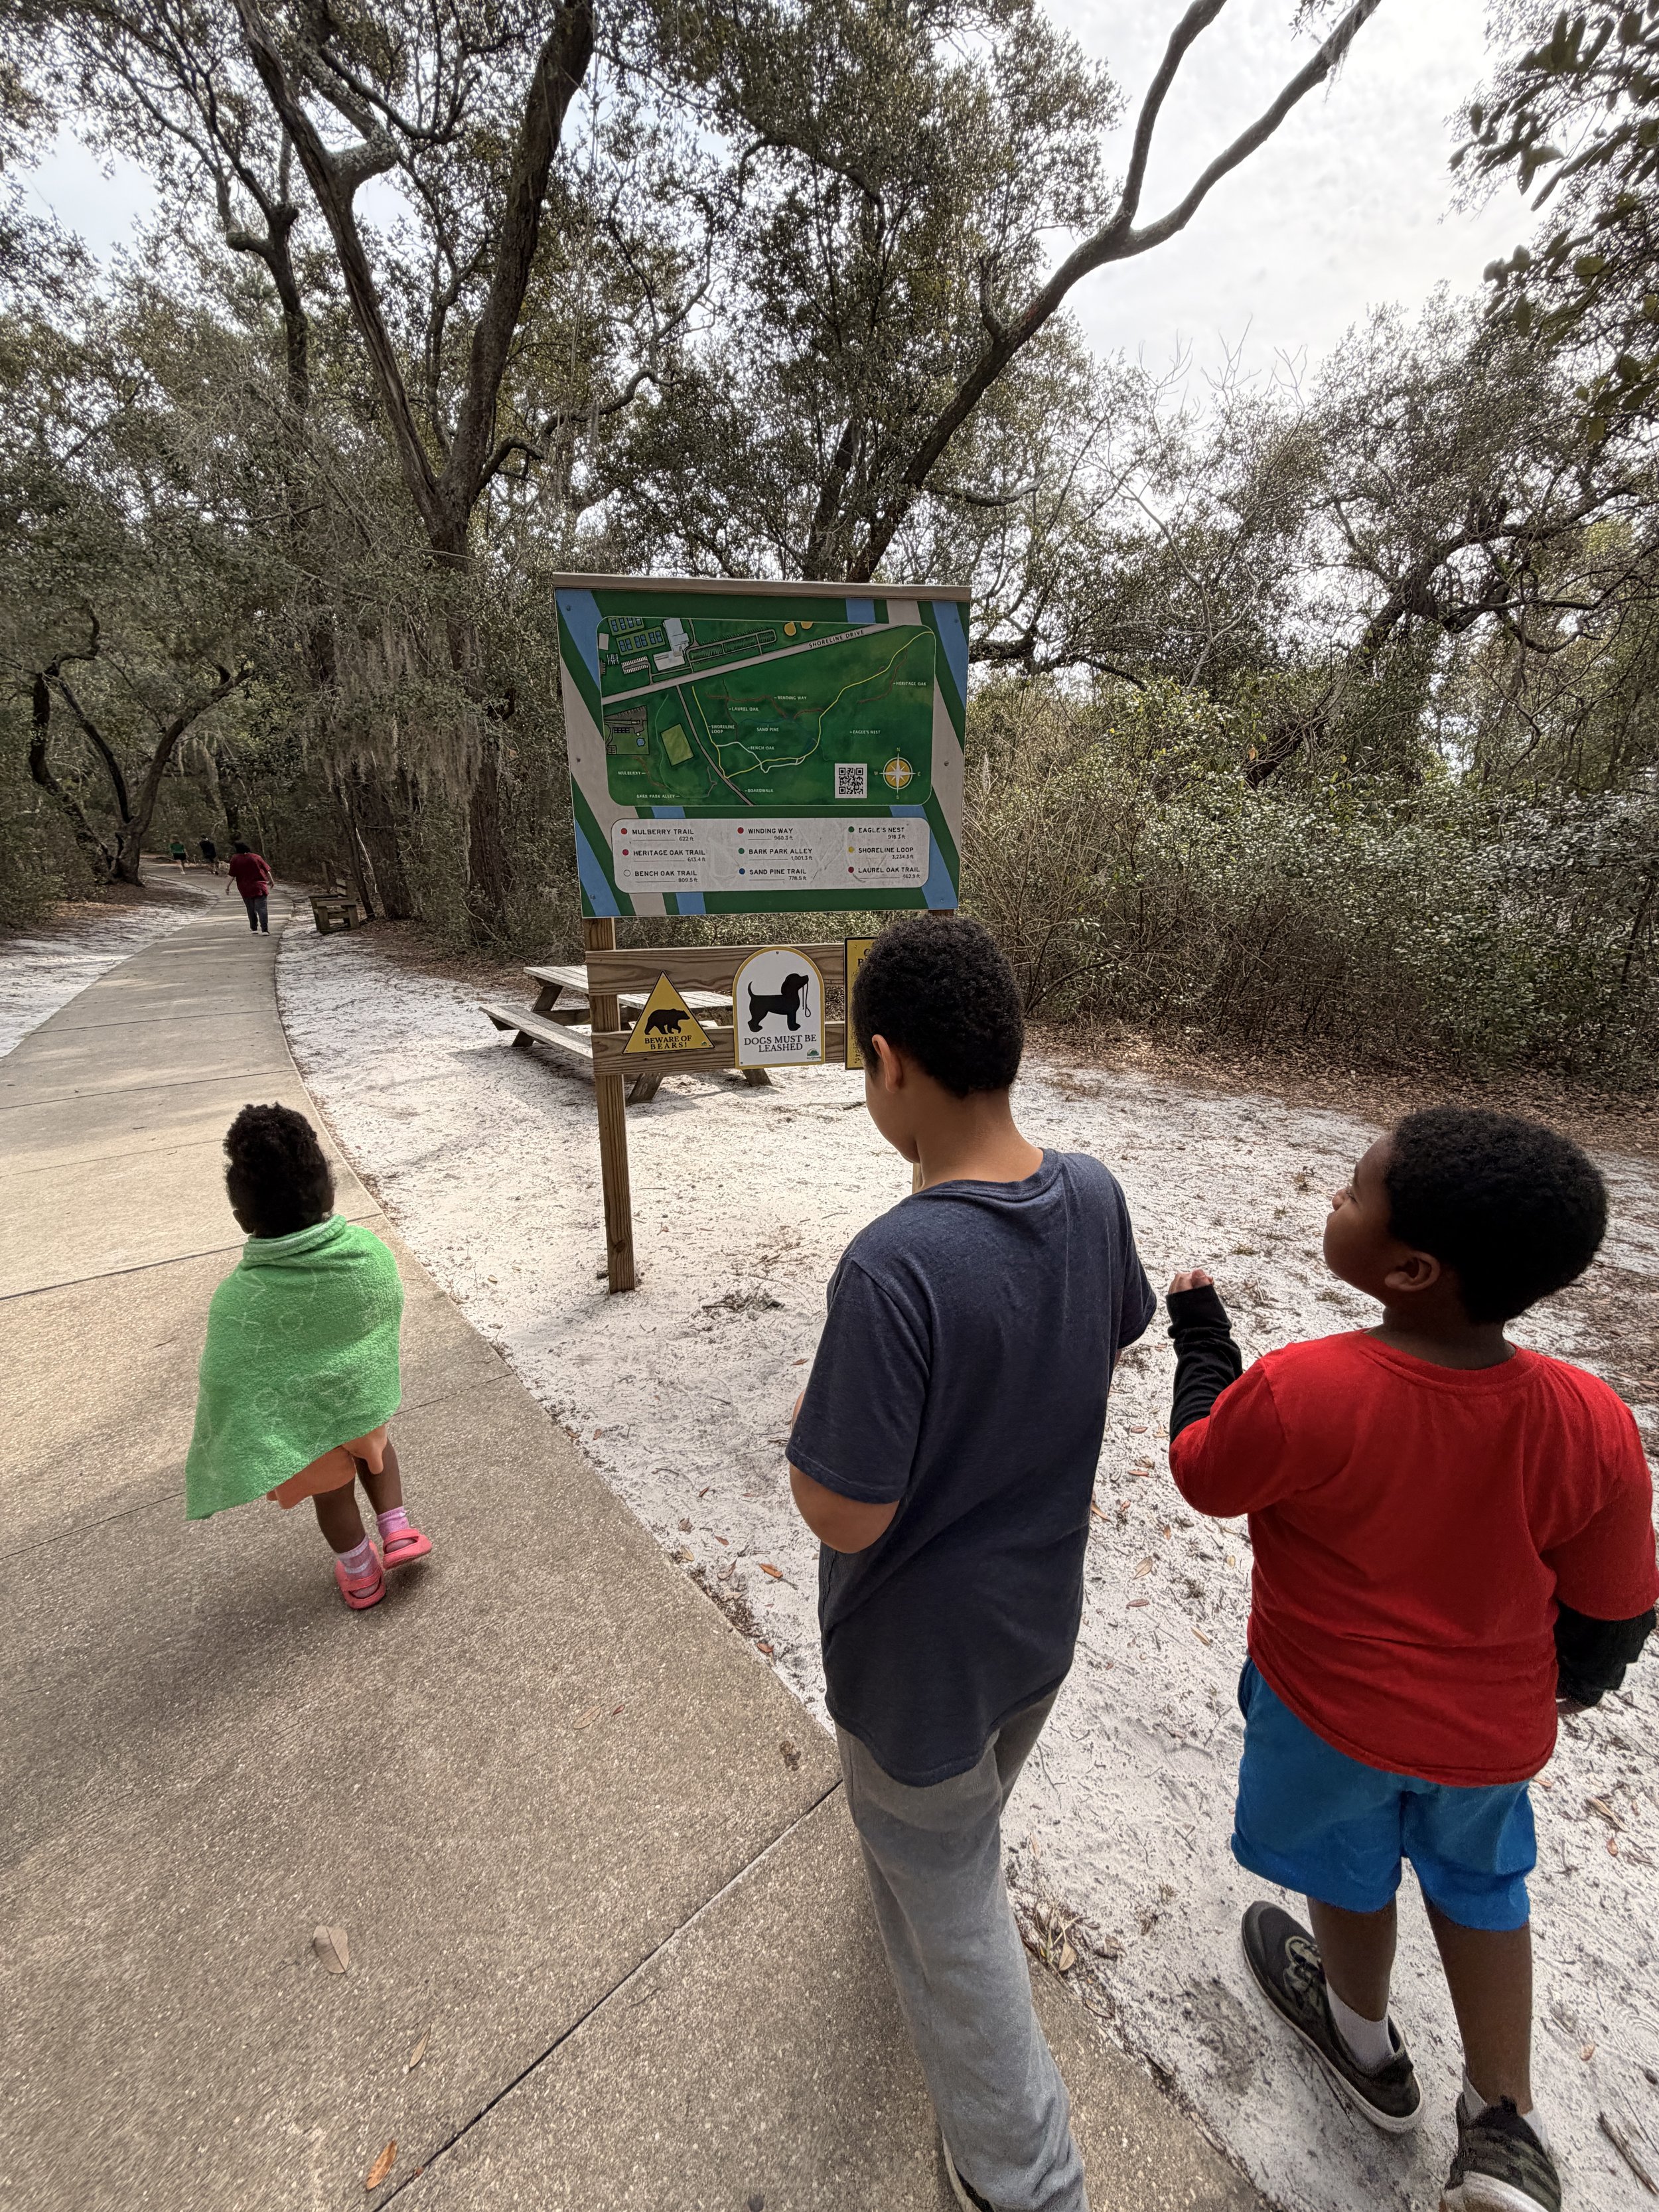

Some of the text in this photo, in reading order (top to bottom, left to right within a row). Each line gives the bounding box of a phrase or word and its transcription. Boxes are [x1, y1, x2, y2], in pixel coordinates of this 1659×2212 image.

[809, 630, 863, 648] SHORELINE DRIVE
[744, 1037, 772, 1045] DOGS
[774, 1035, 803, 1044] MUST
[758, 1043, 803, 1053] LEASHED
